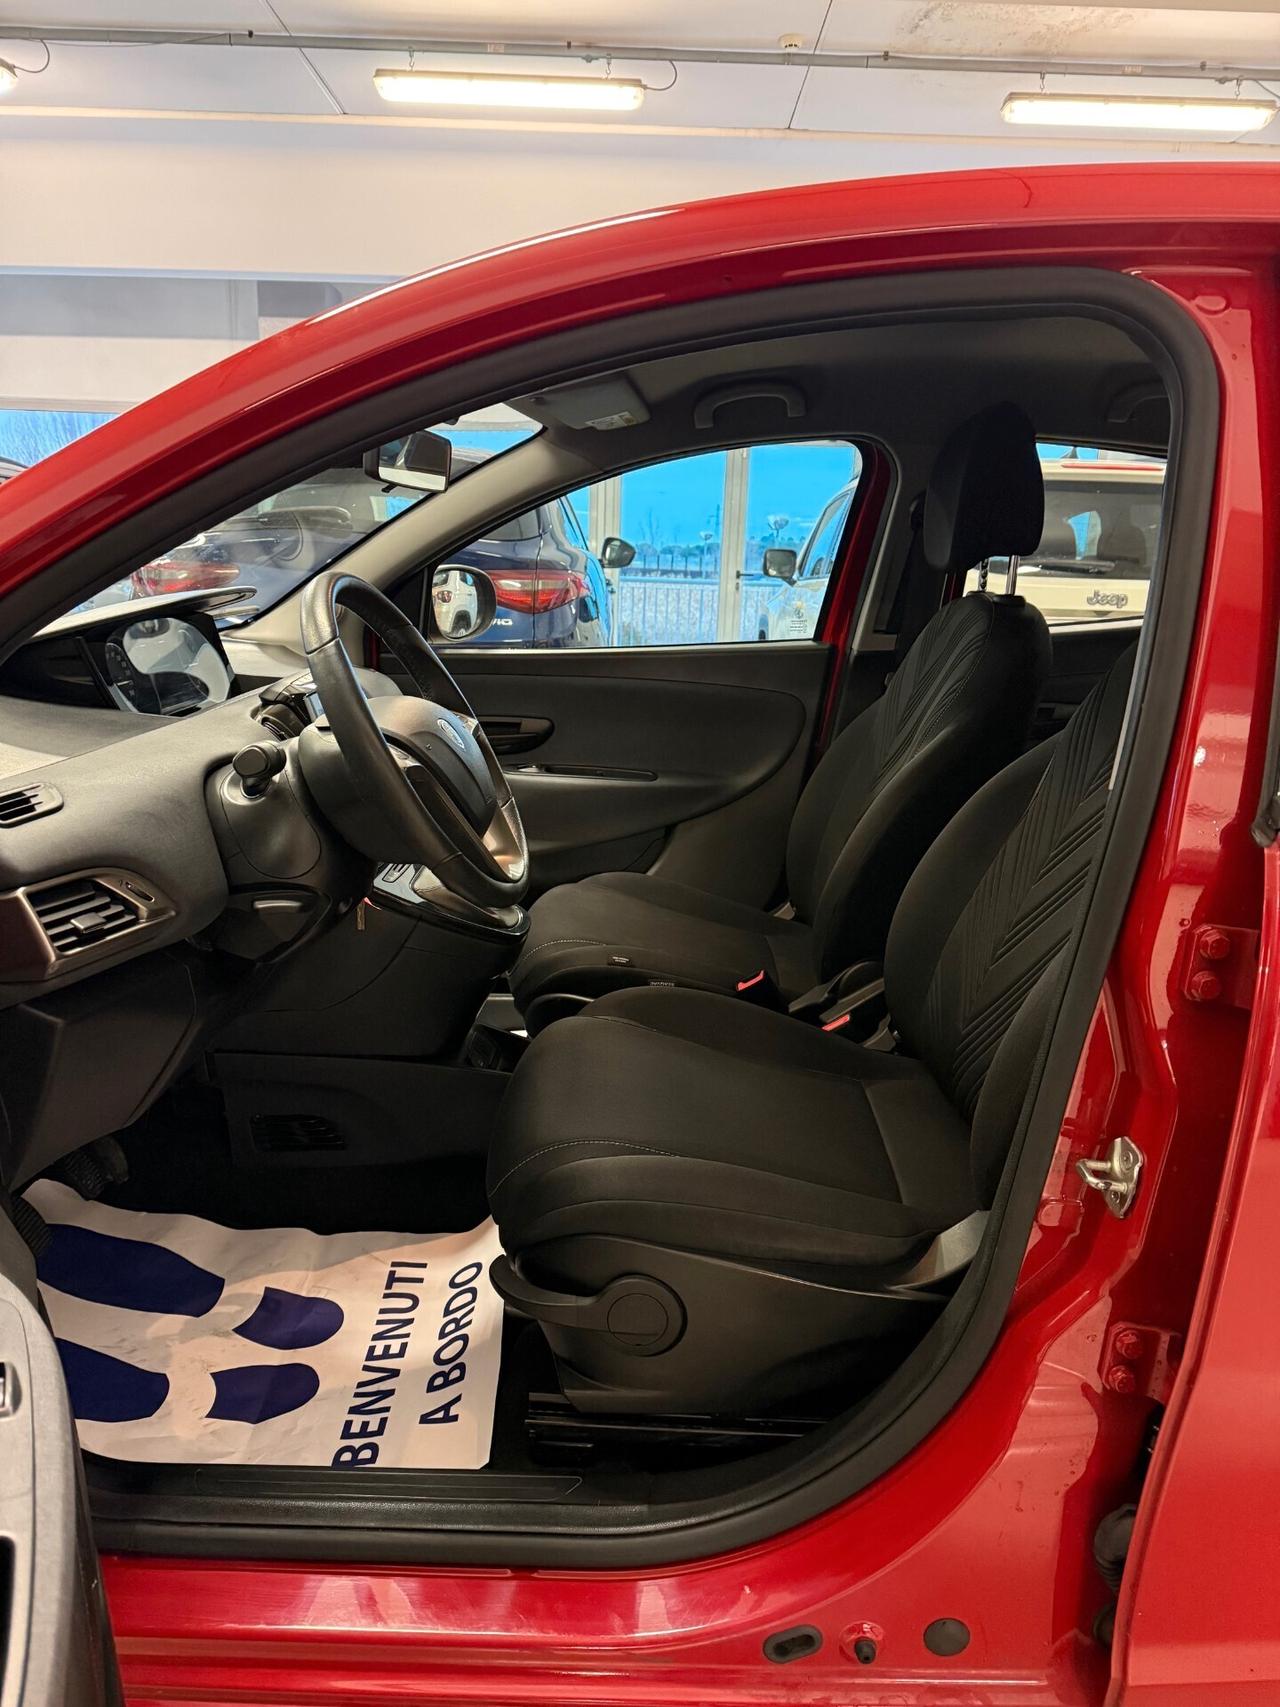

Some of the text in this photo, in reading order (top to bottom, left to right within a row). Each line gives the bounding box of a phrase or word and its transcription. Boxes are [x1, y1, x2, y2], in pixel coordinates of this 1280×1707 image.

[1086, 589, 1128, 608] Jeep
[331, 1261, 428, 1469] BENVENUTI
[418, 1261, 483, 1425] A BORDO
